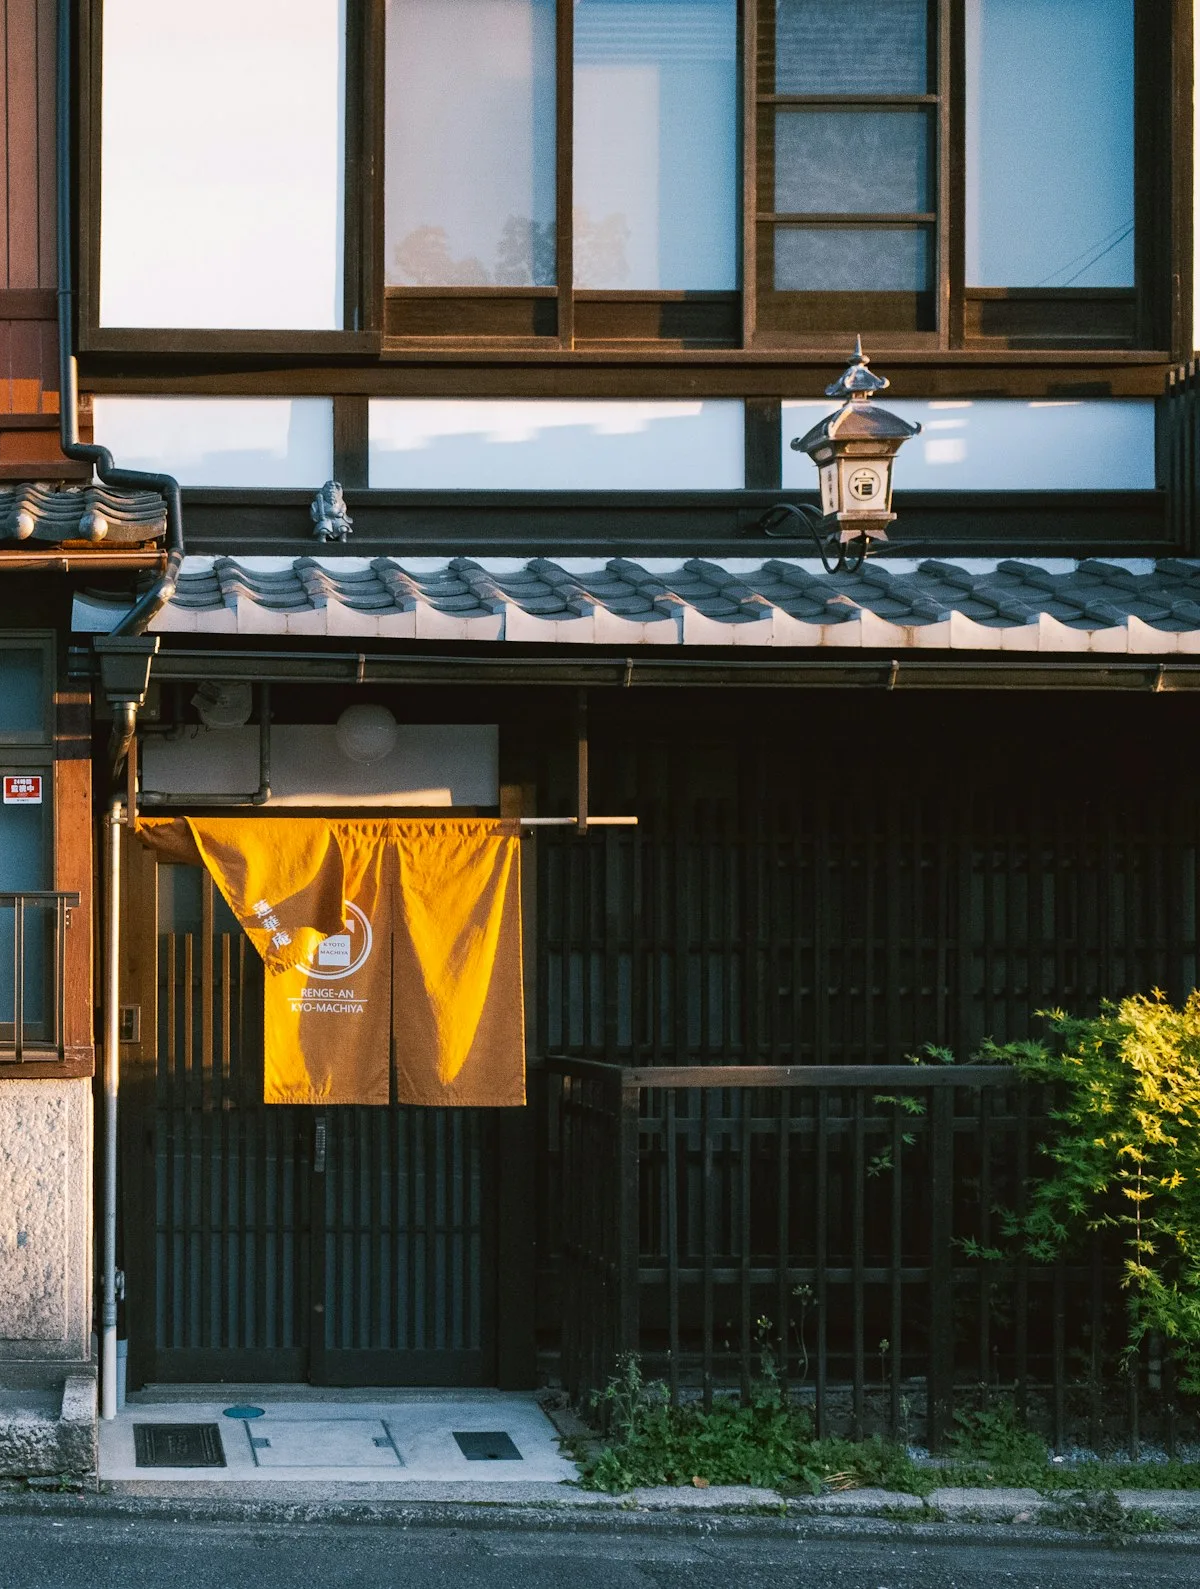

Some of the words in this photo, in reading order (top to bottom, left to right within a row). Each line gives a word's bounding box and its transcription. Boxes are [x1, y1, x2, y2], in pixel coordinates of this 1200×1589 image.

[252, 898, 292, 950] 蓮華庵
[301, 988, 354, 999] RENGE-AN
[291, 1003, 364, 1013] KYO-MACHIYA
